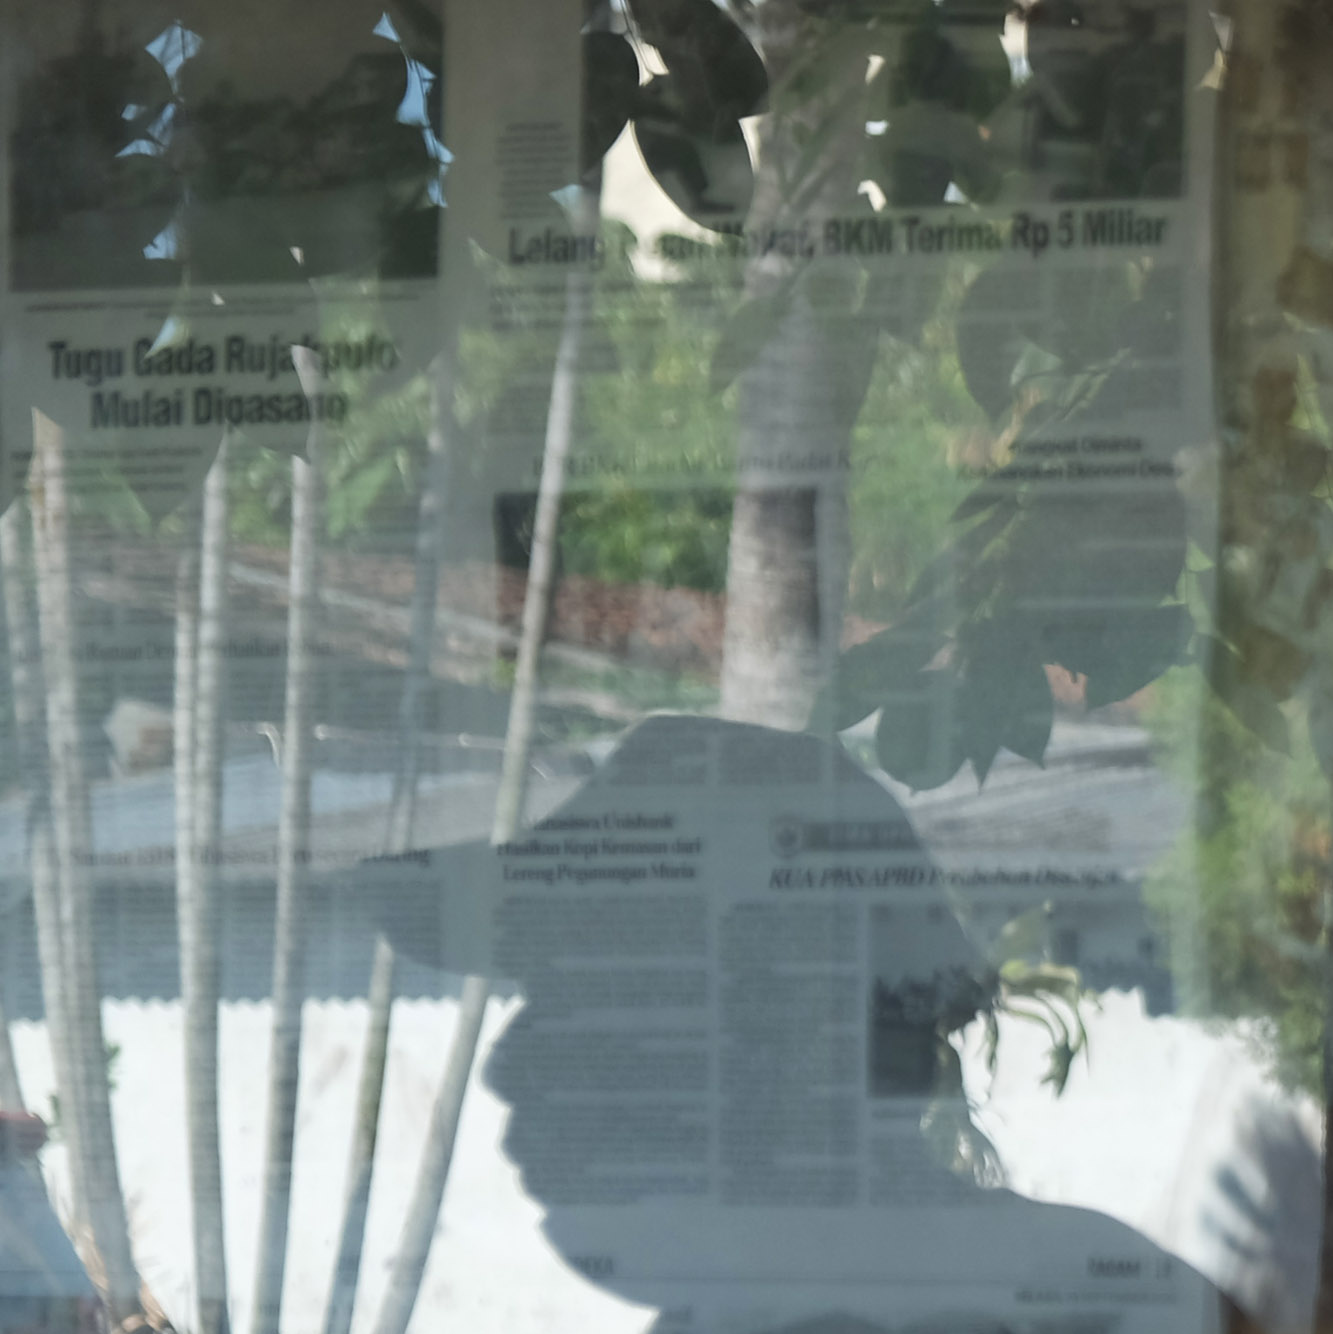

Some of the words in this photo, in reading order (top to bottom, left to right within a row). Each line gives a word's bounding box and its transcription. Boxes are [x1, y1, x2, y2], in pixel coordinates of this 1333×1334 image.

[823, 217, 893, 255] BKM
[903, 216, 999, 256] Terima
[1011, 214, 1049, 258] Rp
[1058, 211, 1074, 246] 5
[1083, 211, 1169, 246] Miliar
[47, 339, 124, 387] Tugu
[90, 389, 182, 429] Mulai
[564, 838, 597, 860] Kopi
[671, 836, 701, 854] dari
[503, 864, 553, 884] Lereng
[769, 866, 813, 889] KUA
